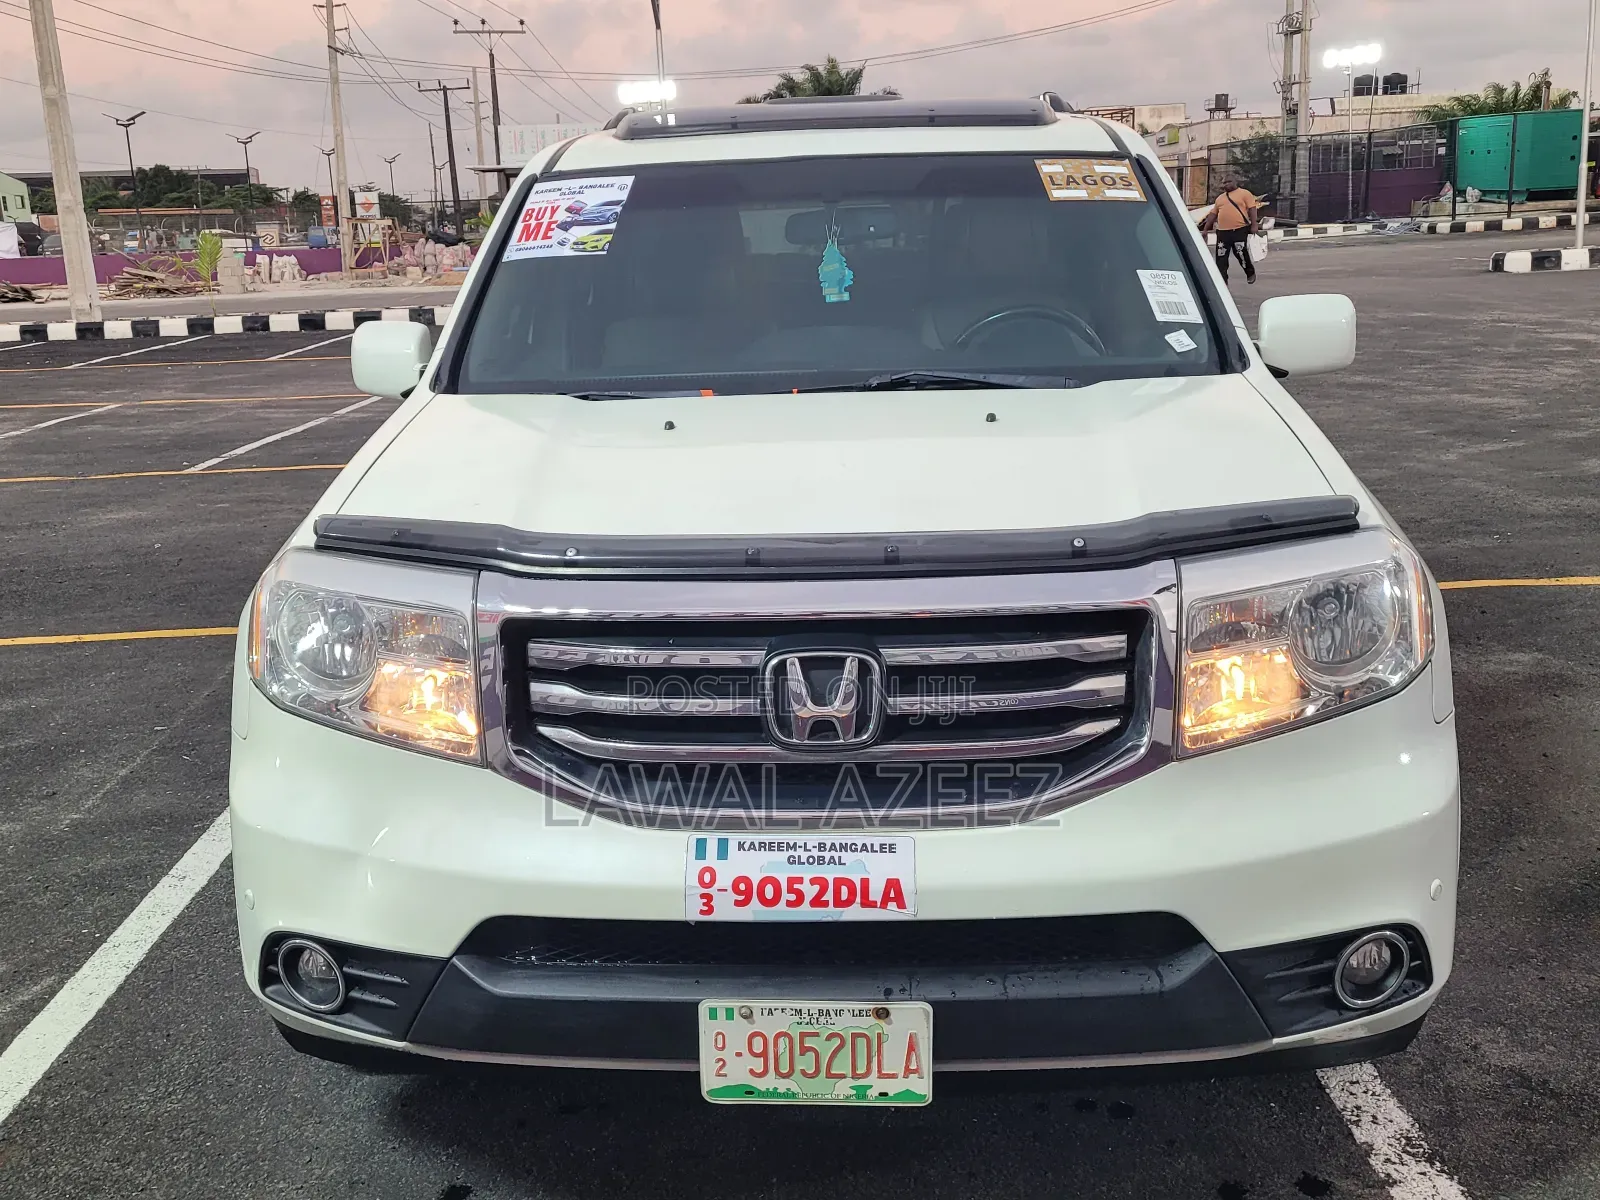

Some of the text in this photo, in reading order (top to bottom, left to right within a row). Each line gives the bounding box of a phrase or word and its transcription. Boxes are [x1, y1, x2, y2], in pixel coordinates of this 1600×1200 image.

[1048, 174, 1133, 187] LAGOS
[559, 189, 585, 197] GLOBAL
[521, 205, 561, 223] BUY
[516, 220, 559, 243] ME
[1149, 272, 1177, 280] 08570
[737, 841, 897, 853] KAREEM-L-BANGALEE
[787, 855, 846, 866] GLOBAL
